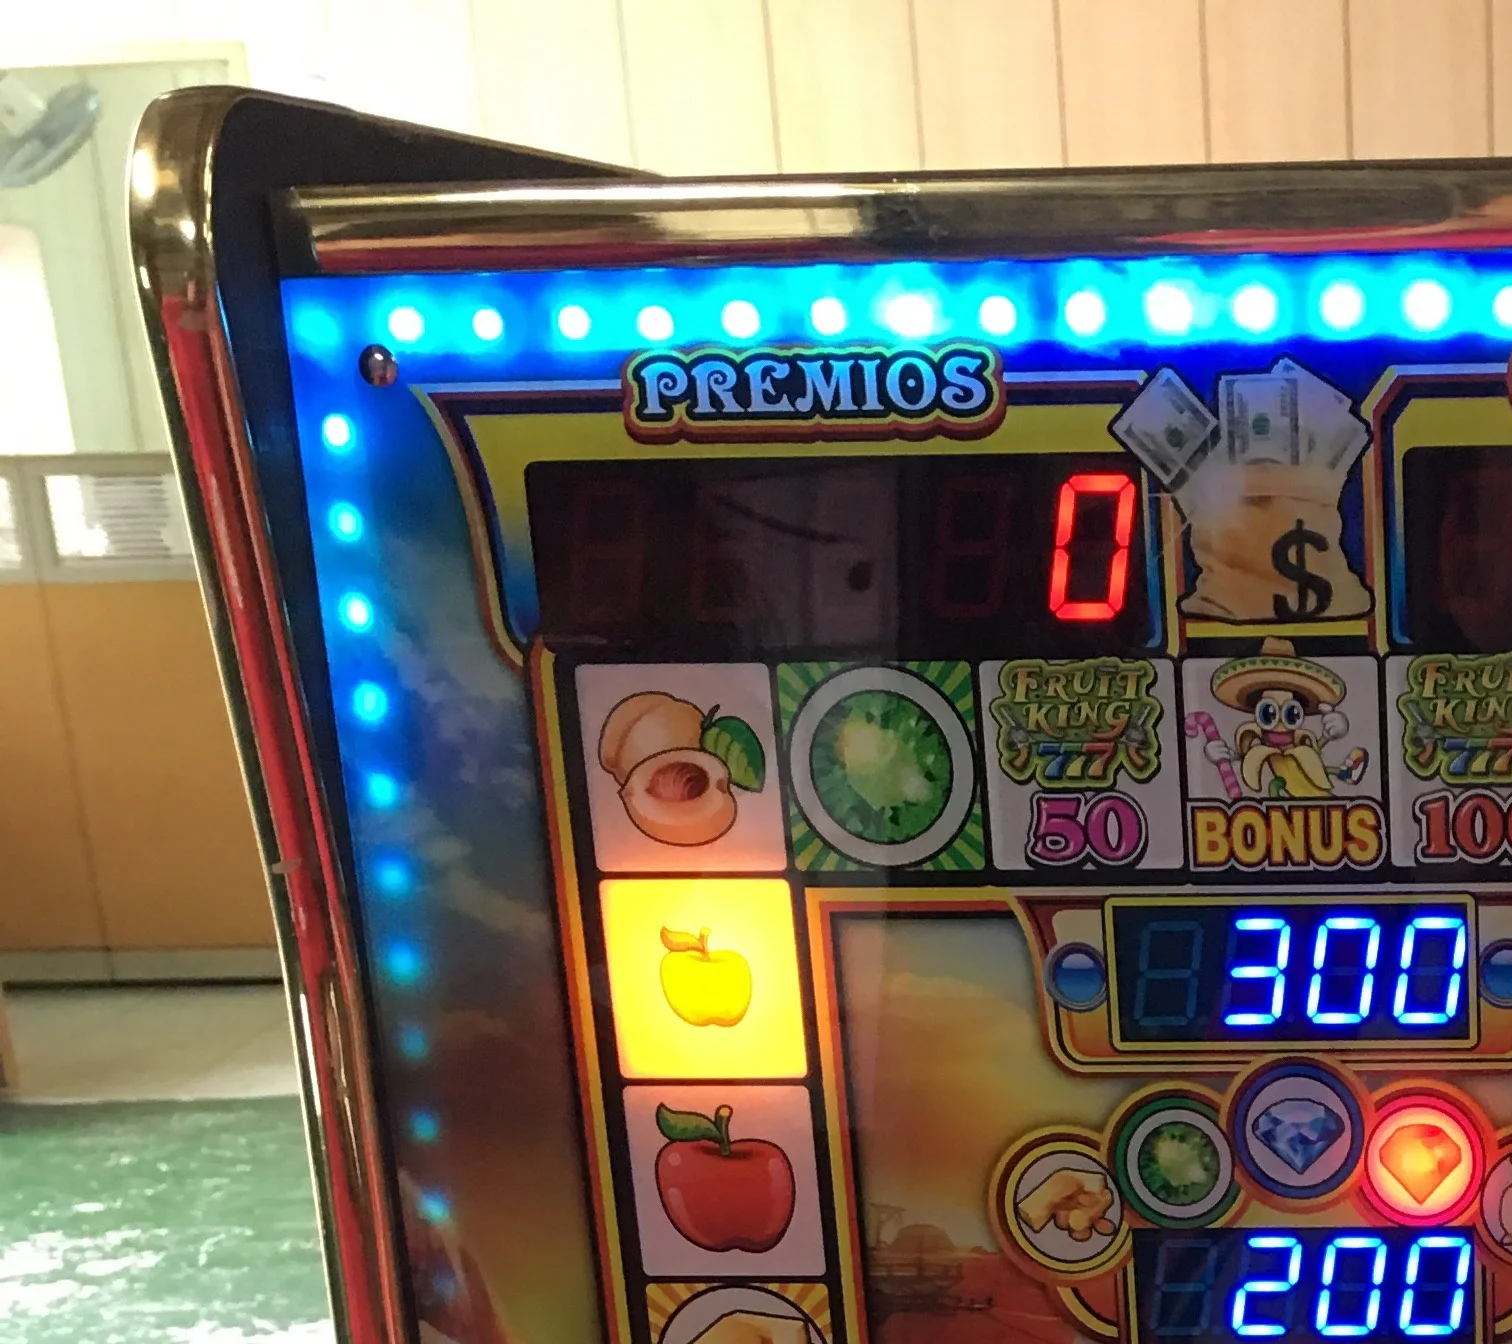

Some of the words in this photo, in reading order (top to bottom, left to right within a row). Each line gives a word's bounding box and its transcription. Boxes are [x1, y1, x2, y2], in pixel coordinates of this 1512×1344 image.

[640, 355, 989, 418] PREMIOS
[1050, 474, 1136, 620] 0
[1013, 665, 1142, 699] FRUIT
[1023, 697, 1131, 741] KING
[1036, 741, 1118, 780] 777
[1033, 797, 1142, 863] 50
[1192, 804, 1383, 868] BONUS
[1223, 916, 1466, 1026] 300
[1232, 1236, 1471, 1337] 200
